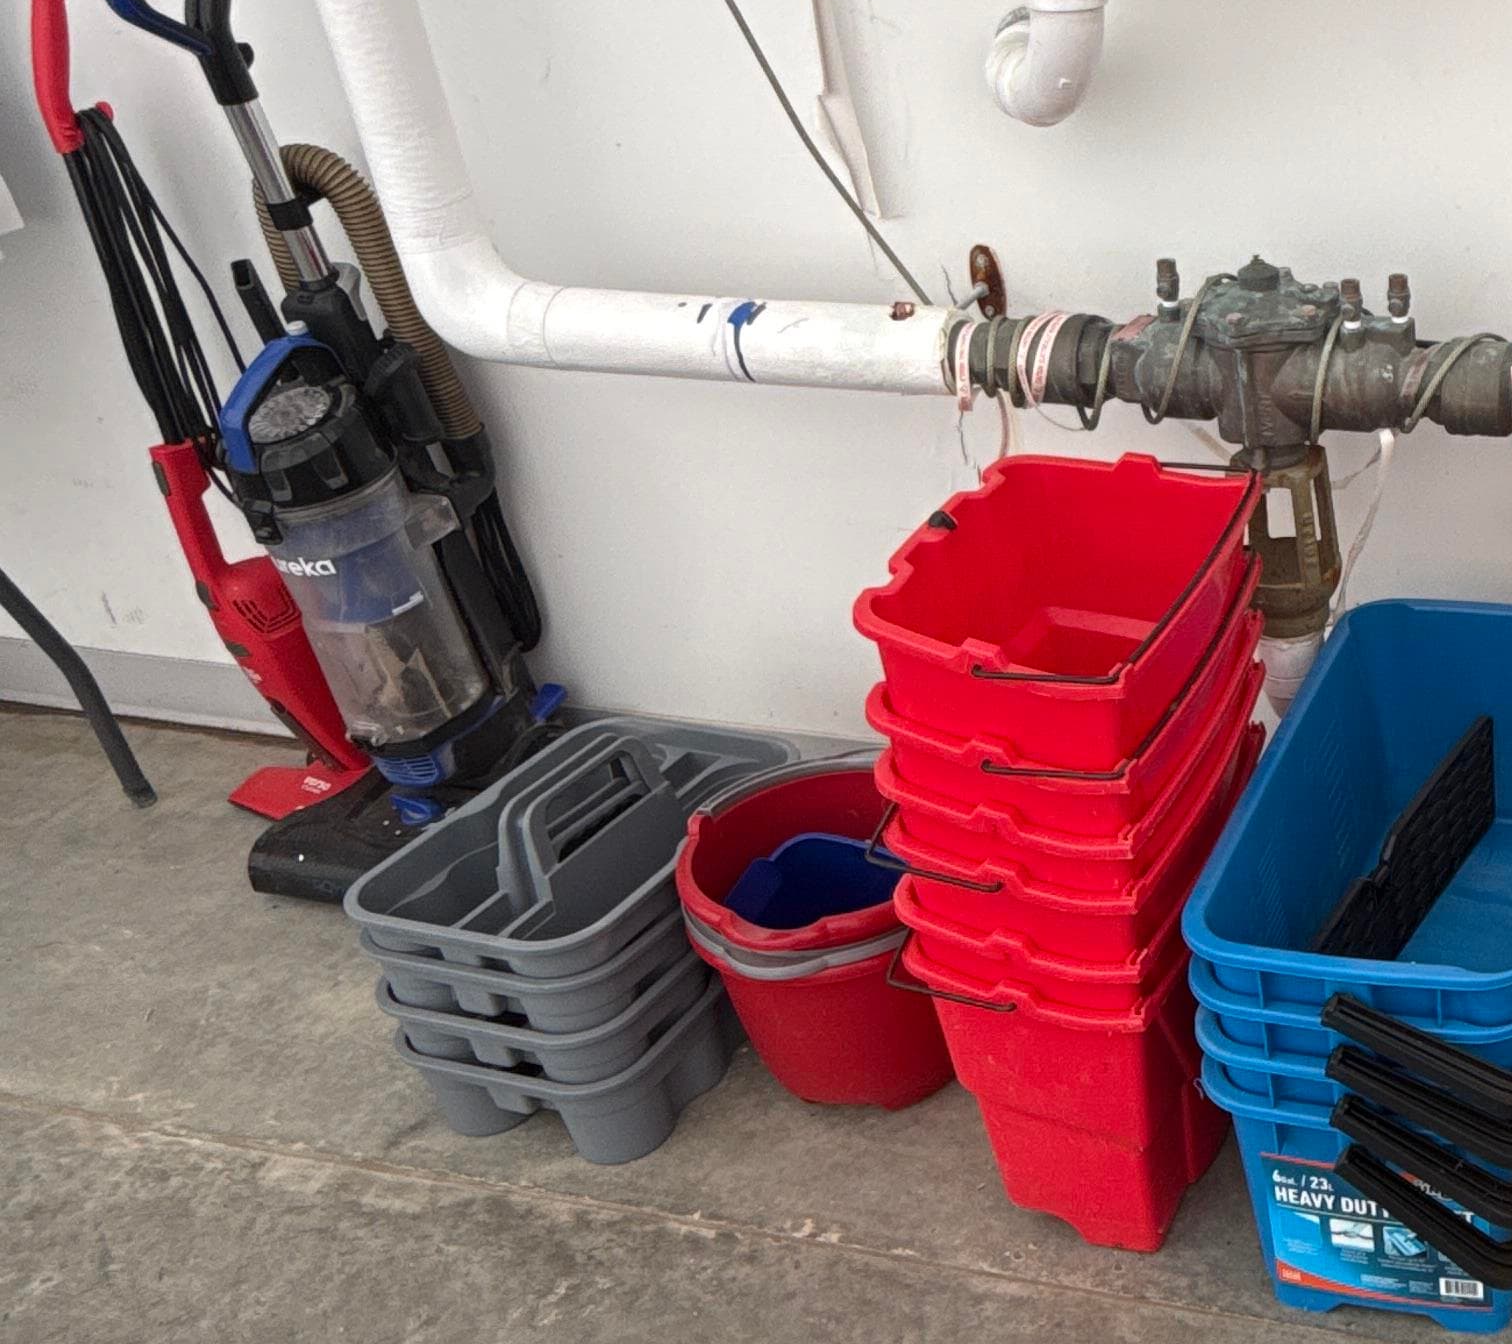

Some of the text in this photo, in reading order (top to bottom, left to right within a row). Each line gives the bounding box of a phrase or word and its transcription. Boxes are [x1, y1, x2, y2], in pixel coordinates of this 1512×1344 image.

[276, 556, 337, 577] reka
[1301, 1173, 1306, 1187] /
[1274, 1184, 1336, 1210] HEAVY
